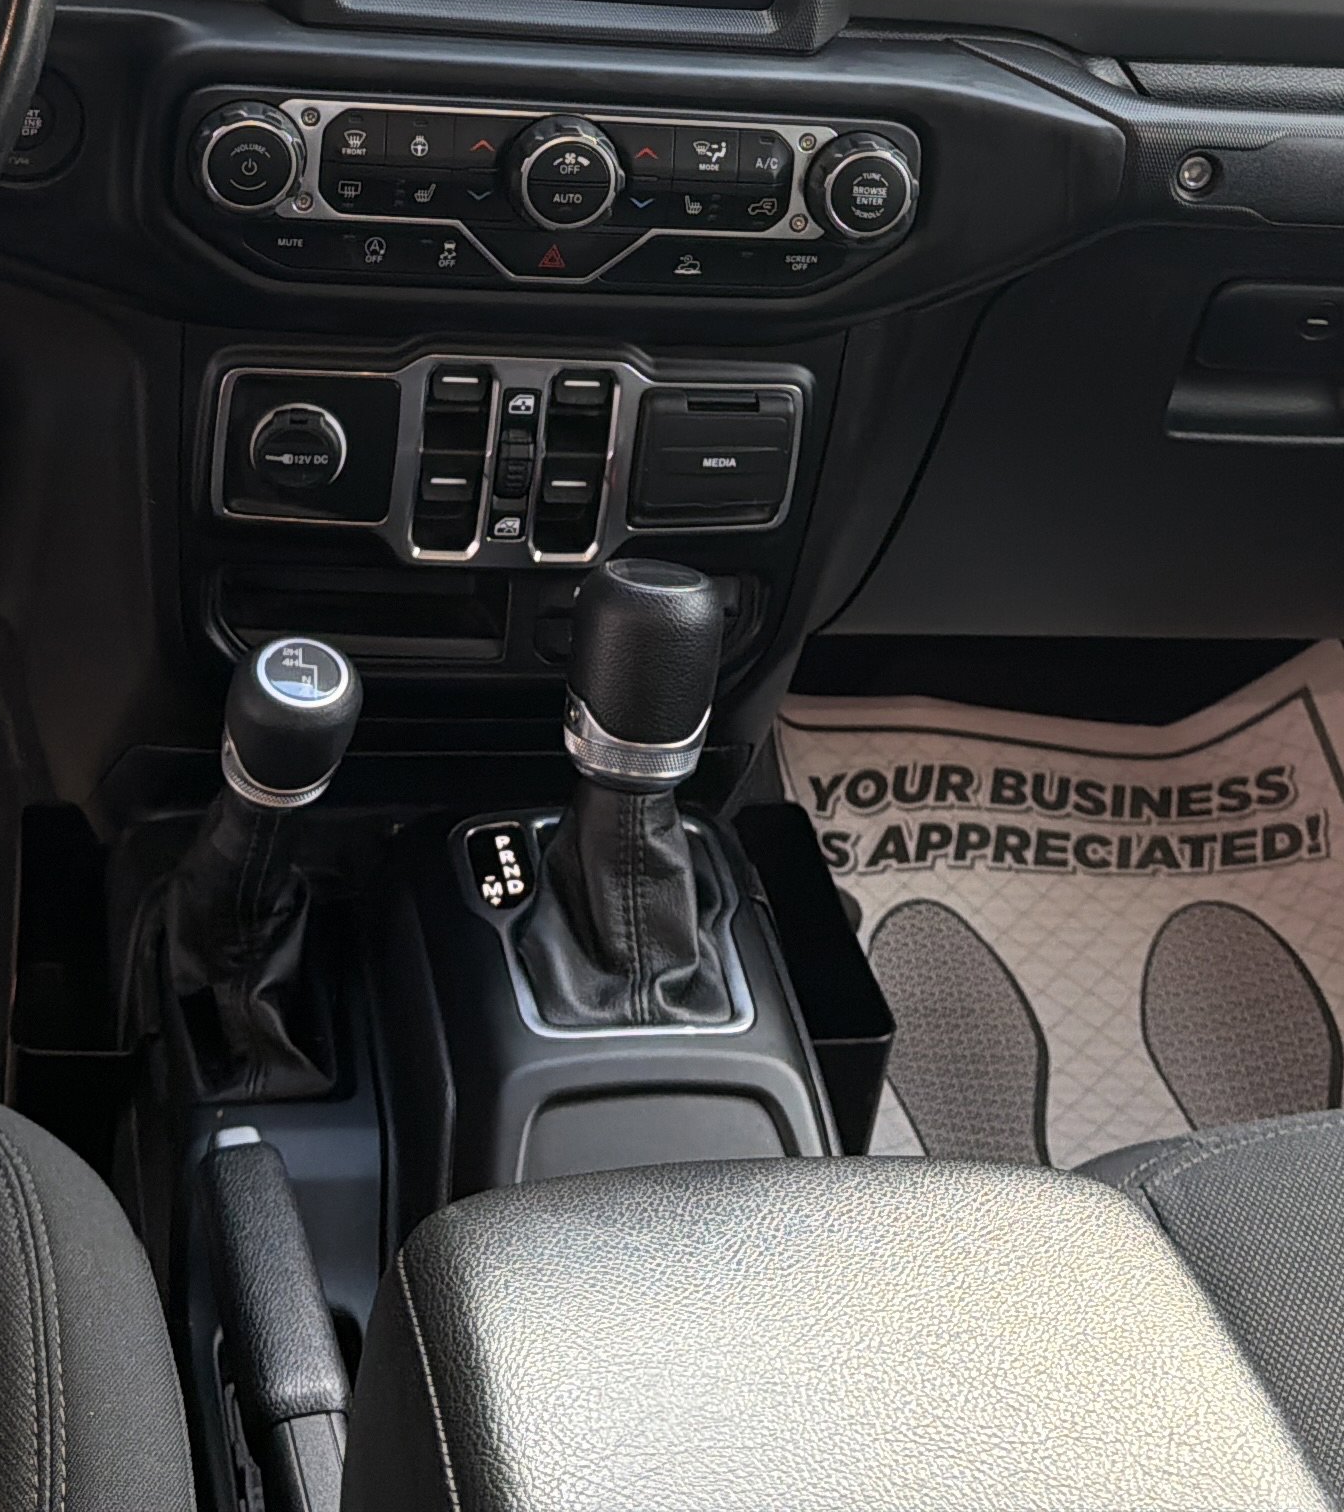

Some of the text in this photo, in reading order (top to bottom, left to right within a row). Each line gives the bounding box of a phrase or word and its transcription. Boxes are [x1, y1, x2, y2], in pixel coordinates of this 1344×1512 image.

[234, 143, 267, 155] VOLUME
[341, 147, 367, 156] FRONT
[698, 164, 720, 172] MODE
[755, 157, 779, 170] A/C
[559, 164, 581, 175] OFF
[862, 172, 881, 181] TUNE
[853, 186, 888, 195] BROWSE
[552, 193, 583, 204] AUTO
[856, 196, 884, 206] ENTER
[854, 210, 881, 219] SCROLL
[277, 238, 303, 247] MUTE
[365, 255, 383, 264] OFF
[438, 259, 455, 268] OFF
[785, 255, 818, 264] SCREEN
[791, 263, 808, 271] OFF
[294, 455, 329, 464] 12V DC
[703, 458, 737, 467] MEDIA
[282, 657, 299, 666] 4H
[807, 762, 1297, 821] YOUR BUSINESS
[495, 835, 511, 849] P
[820, 812, 1329, 873] S APPRECIATED!
[499, 850, 516, 865] R
[503, 863, 521, 879] N
[482, 881, 504, 900] M
[507, 879, 524, 895] D
